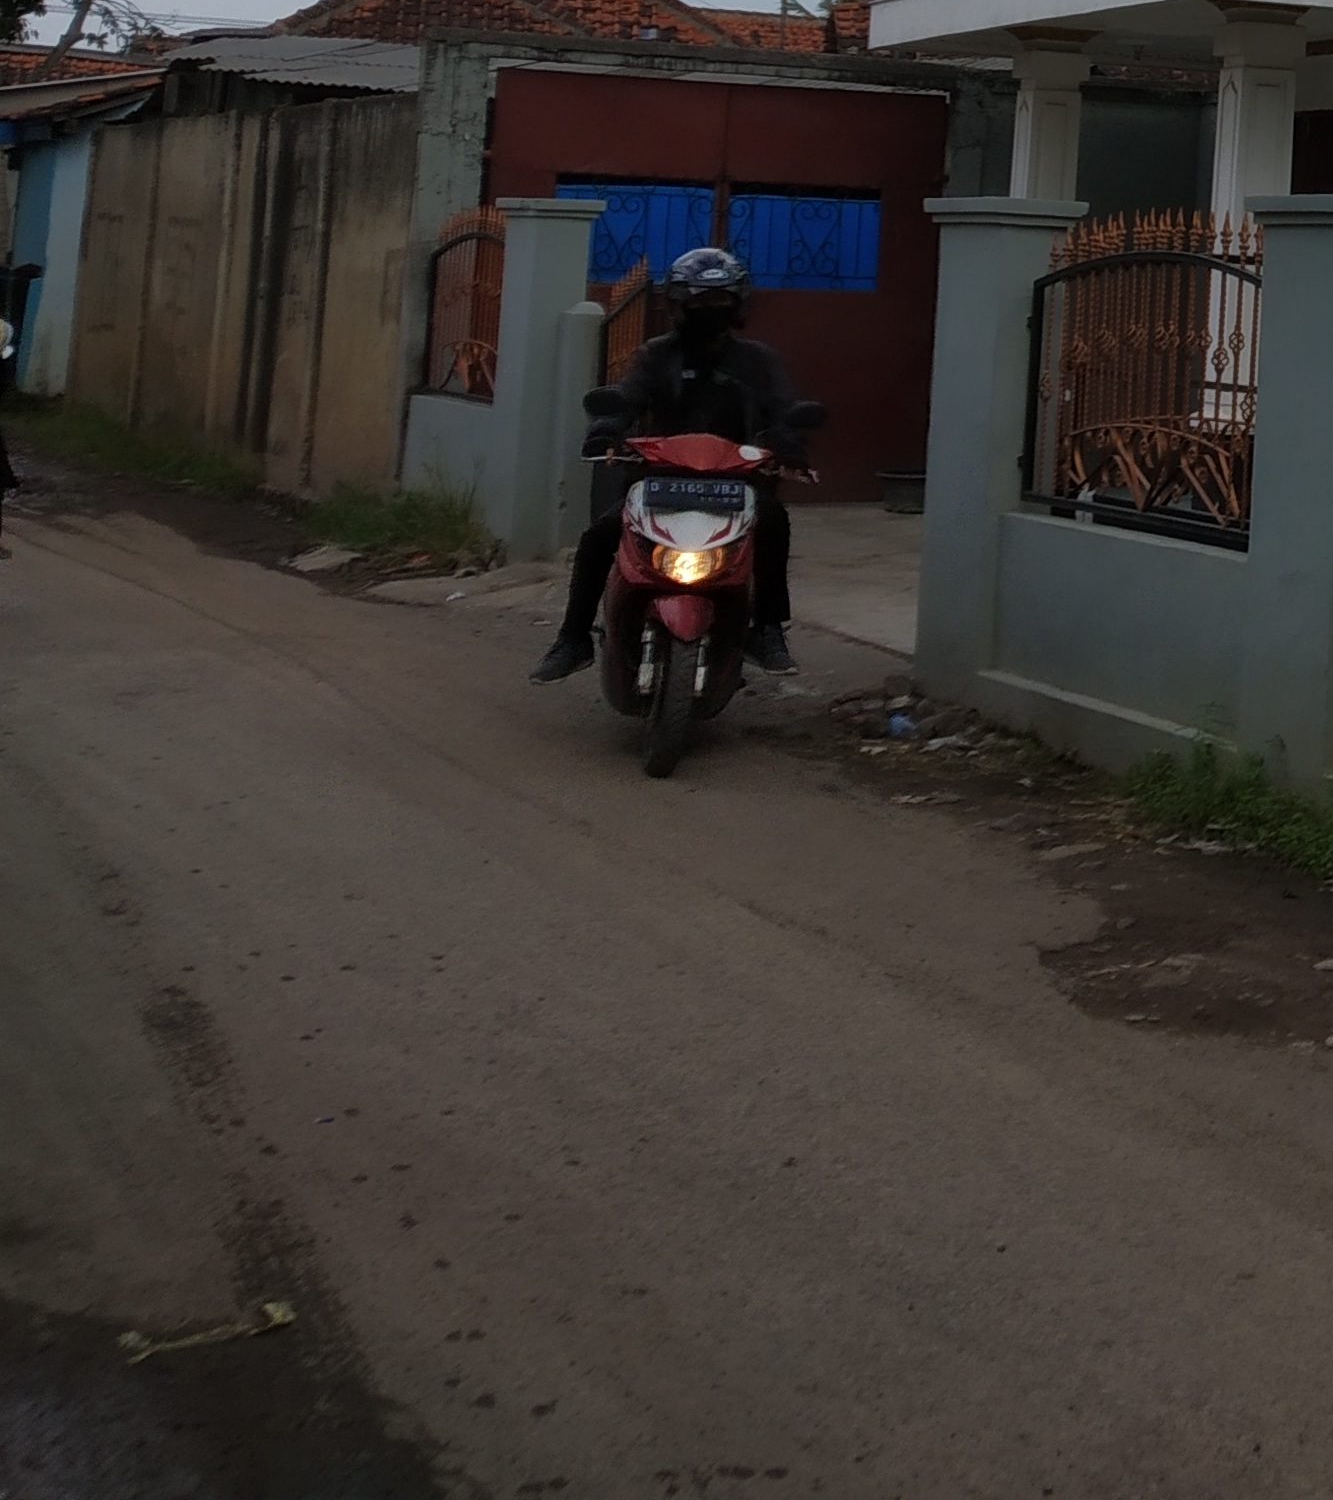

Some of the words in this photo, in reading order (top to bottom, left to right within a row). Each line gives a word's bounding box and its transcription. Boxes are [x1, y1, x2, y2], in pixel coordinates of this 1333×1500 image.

[650, 482, 660, 492] D
[669, 483, 705, 494] 2165
[712, 484, 740, 495] VBJ
